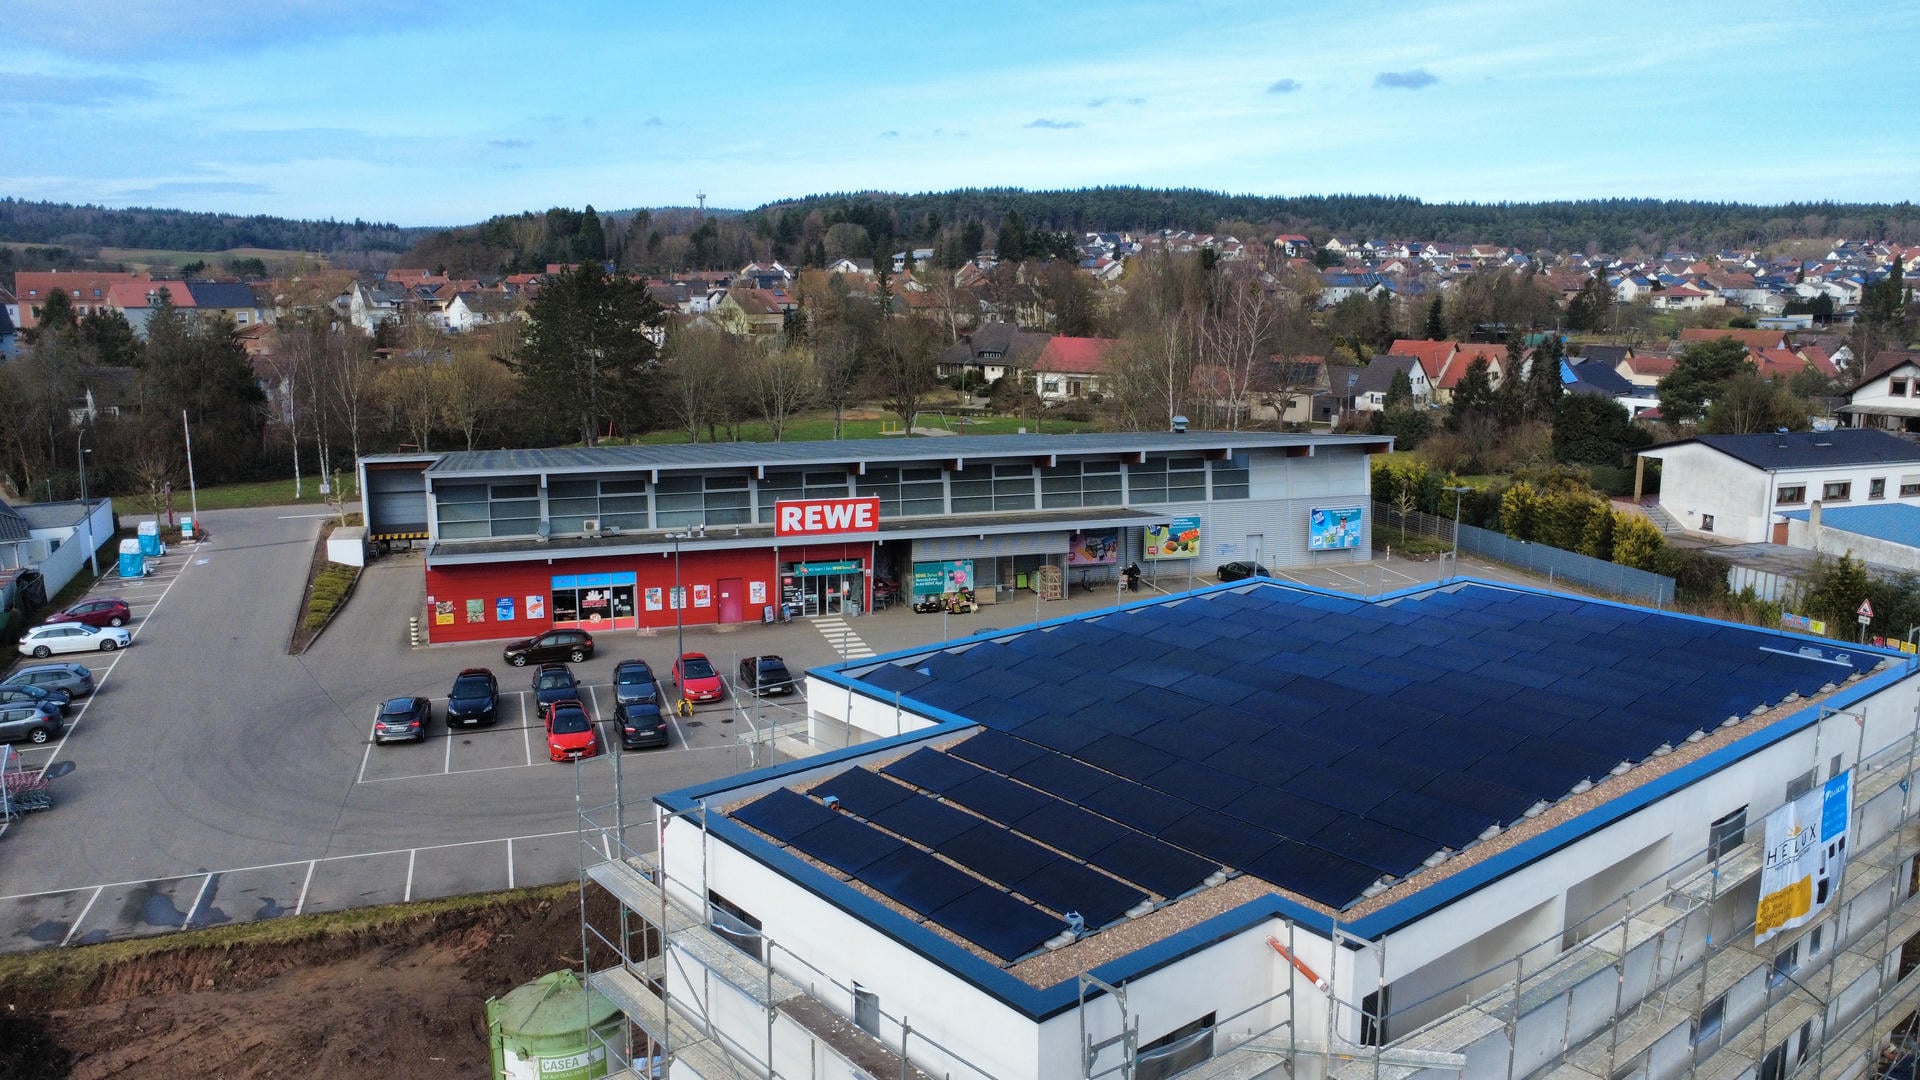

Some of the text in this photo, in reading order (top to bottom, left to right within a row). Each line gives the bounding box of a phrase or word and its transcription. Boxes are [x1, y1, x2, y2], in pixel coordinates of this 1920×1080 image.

[781, 503, 873, 531] REWE
[1766, 823, 1817, 865] HELUX
[543, 1057, 580, 1071] CASEA
